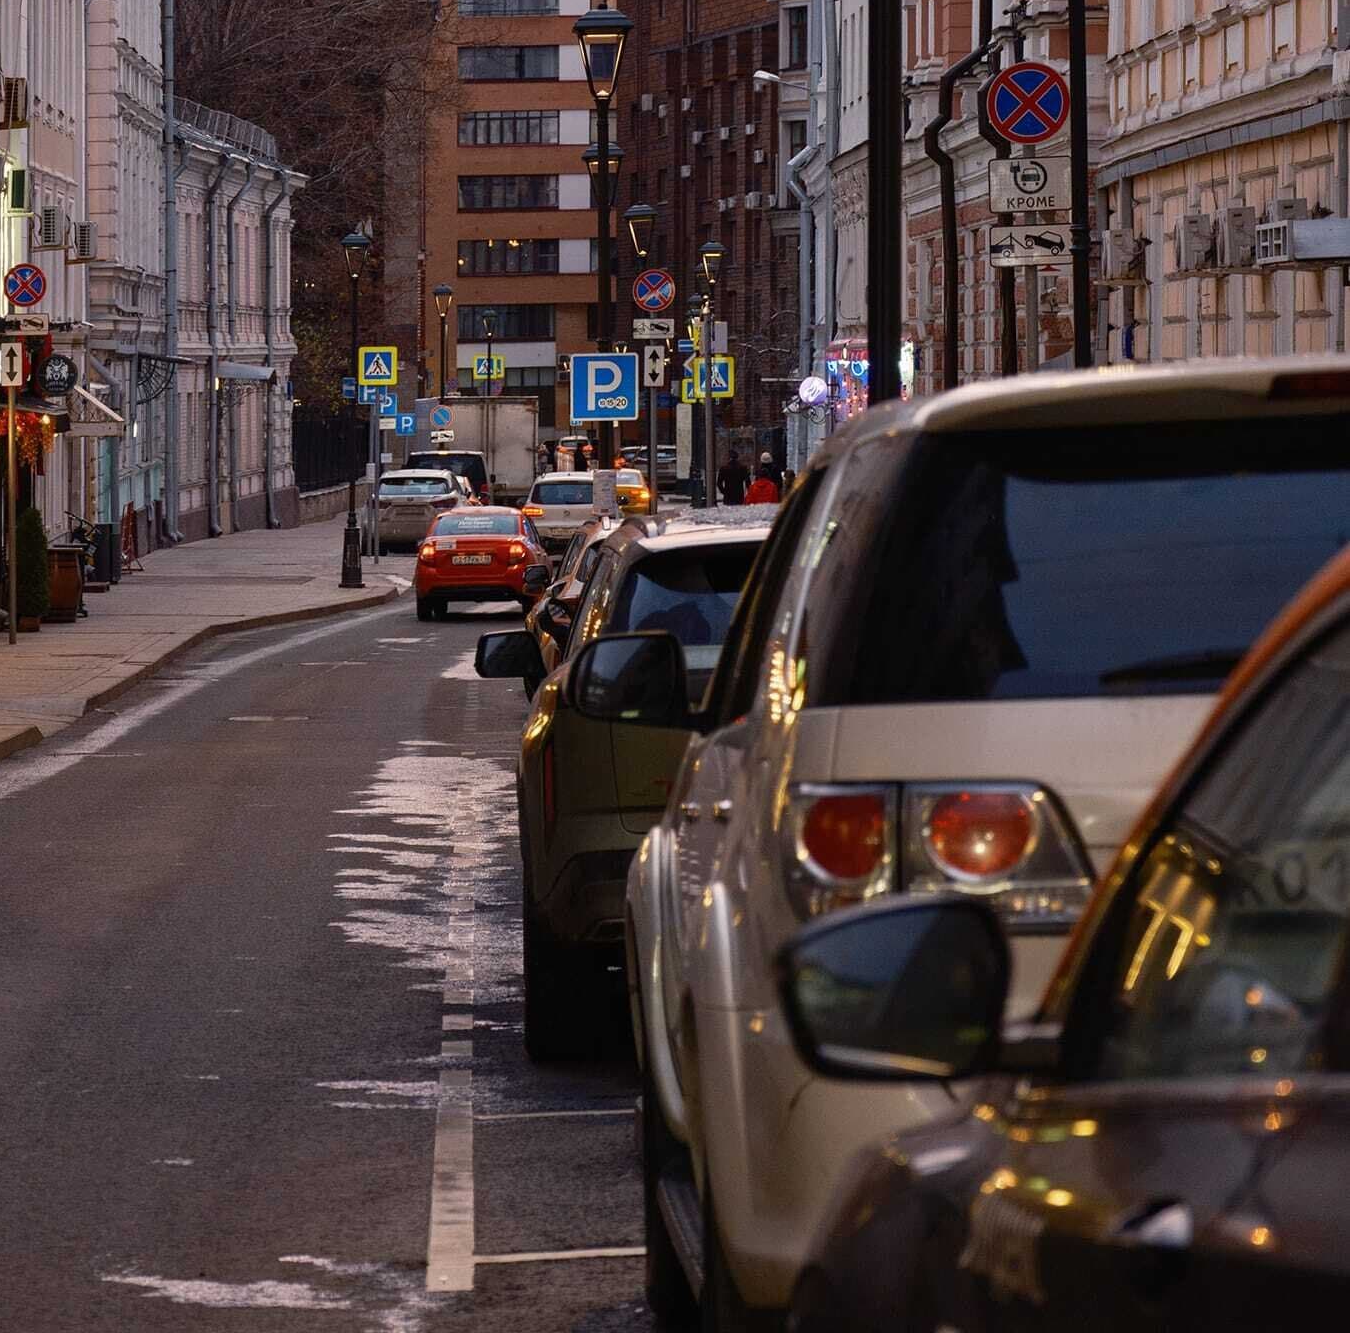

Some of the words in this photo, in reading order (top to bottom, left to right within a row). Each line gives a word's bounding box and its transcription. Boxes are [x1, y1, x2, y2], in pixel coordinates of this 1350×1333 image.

[1006, 195, 1056, 209] КРОМЕ
[587, 361, 622, 411] P
[616, 398, 627, 407] 20
